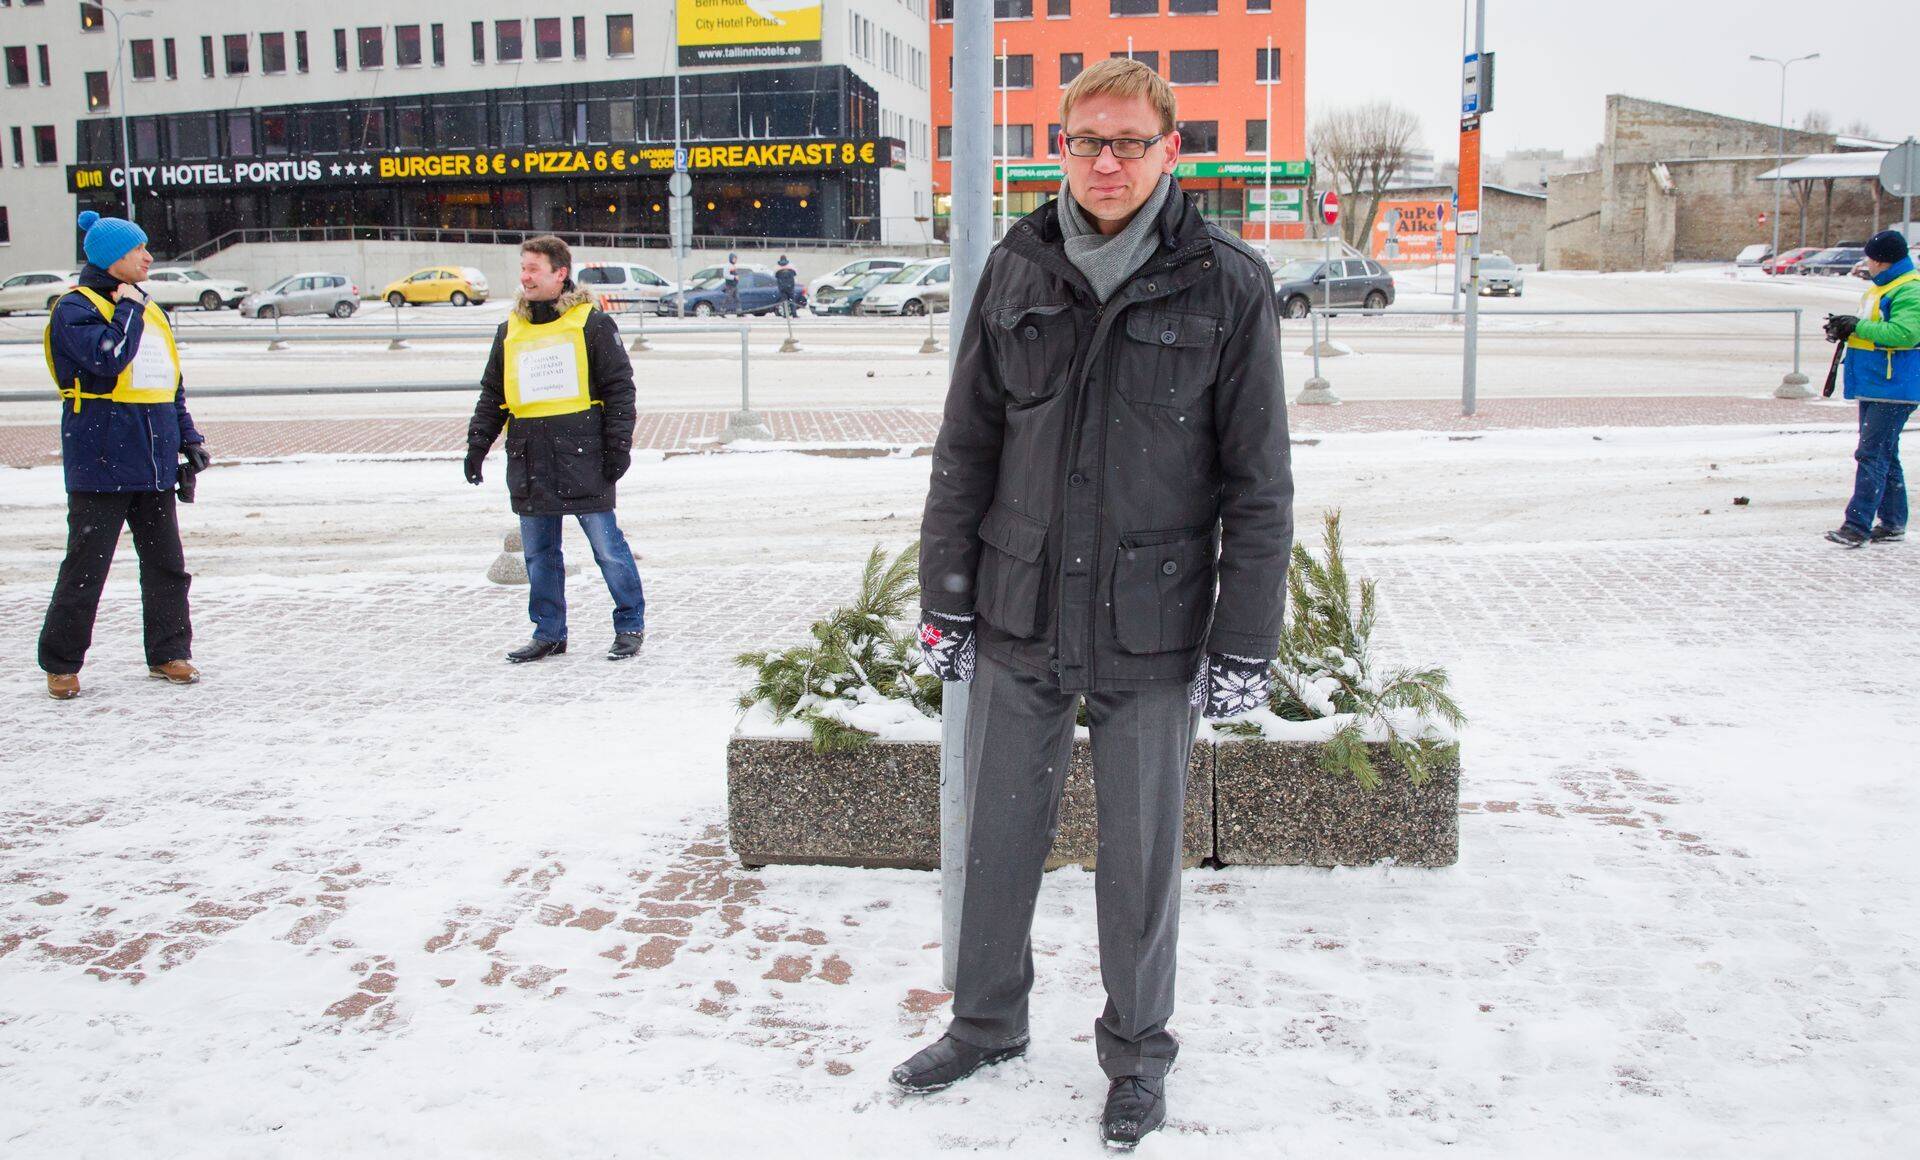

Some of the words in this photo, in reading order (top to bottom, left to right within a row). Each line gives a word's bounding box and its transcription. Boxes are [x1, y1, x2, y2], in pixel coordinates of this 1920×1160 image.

[696, 18, 715, 31] City
[717, 17, 744, 29] Hotel
[746, 15, 778, 27] Portus
[697, 45, 802, 59] www.tallinnhotels.ee
[841, 143, 856, 164] 8
[860, 142, 875, 164] €
[379, 154, 472, 178] BURGER
[475, 153, 489, 175] 8
[492, 153, 507, 174] €
[524, 151, 590, 173] PIZZA
[594, 150, 608, 171] 6
[611, 149, 626, 171] €
[110, 166, 156, 187] CTY
[161, 163, 231, 186] HOTEL
[234, 160, 322, 183] PORTUS
[1394, 207, 1437, 219] SuPe
